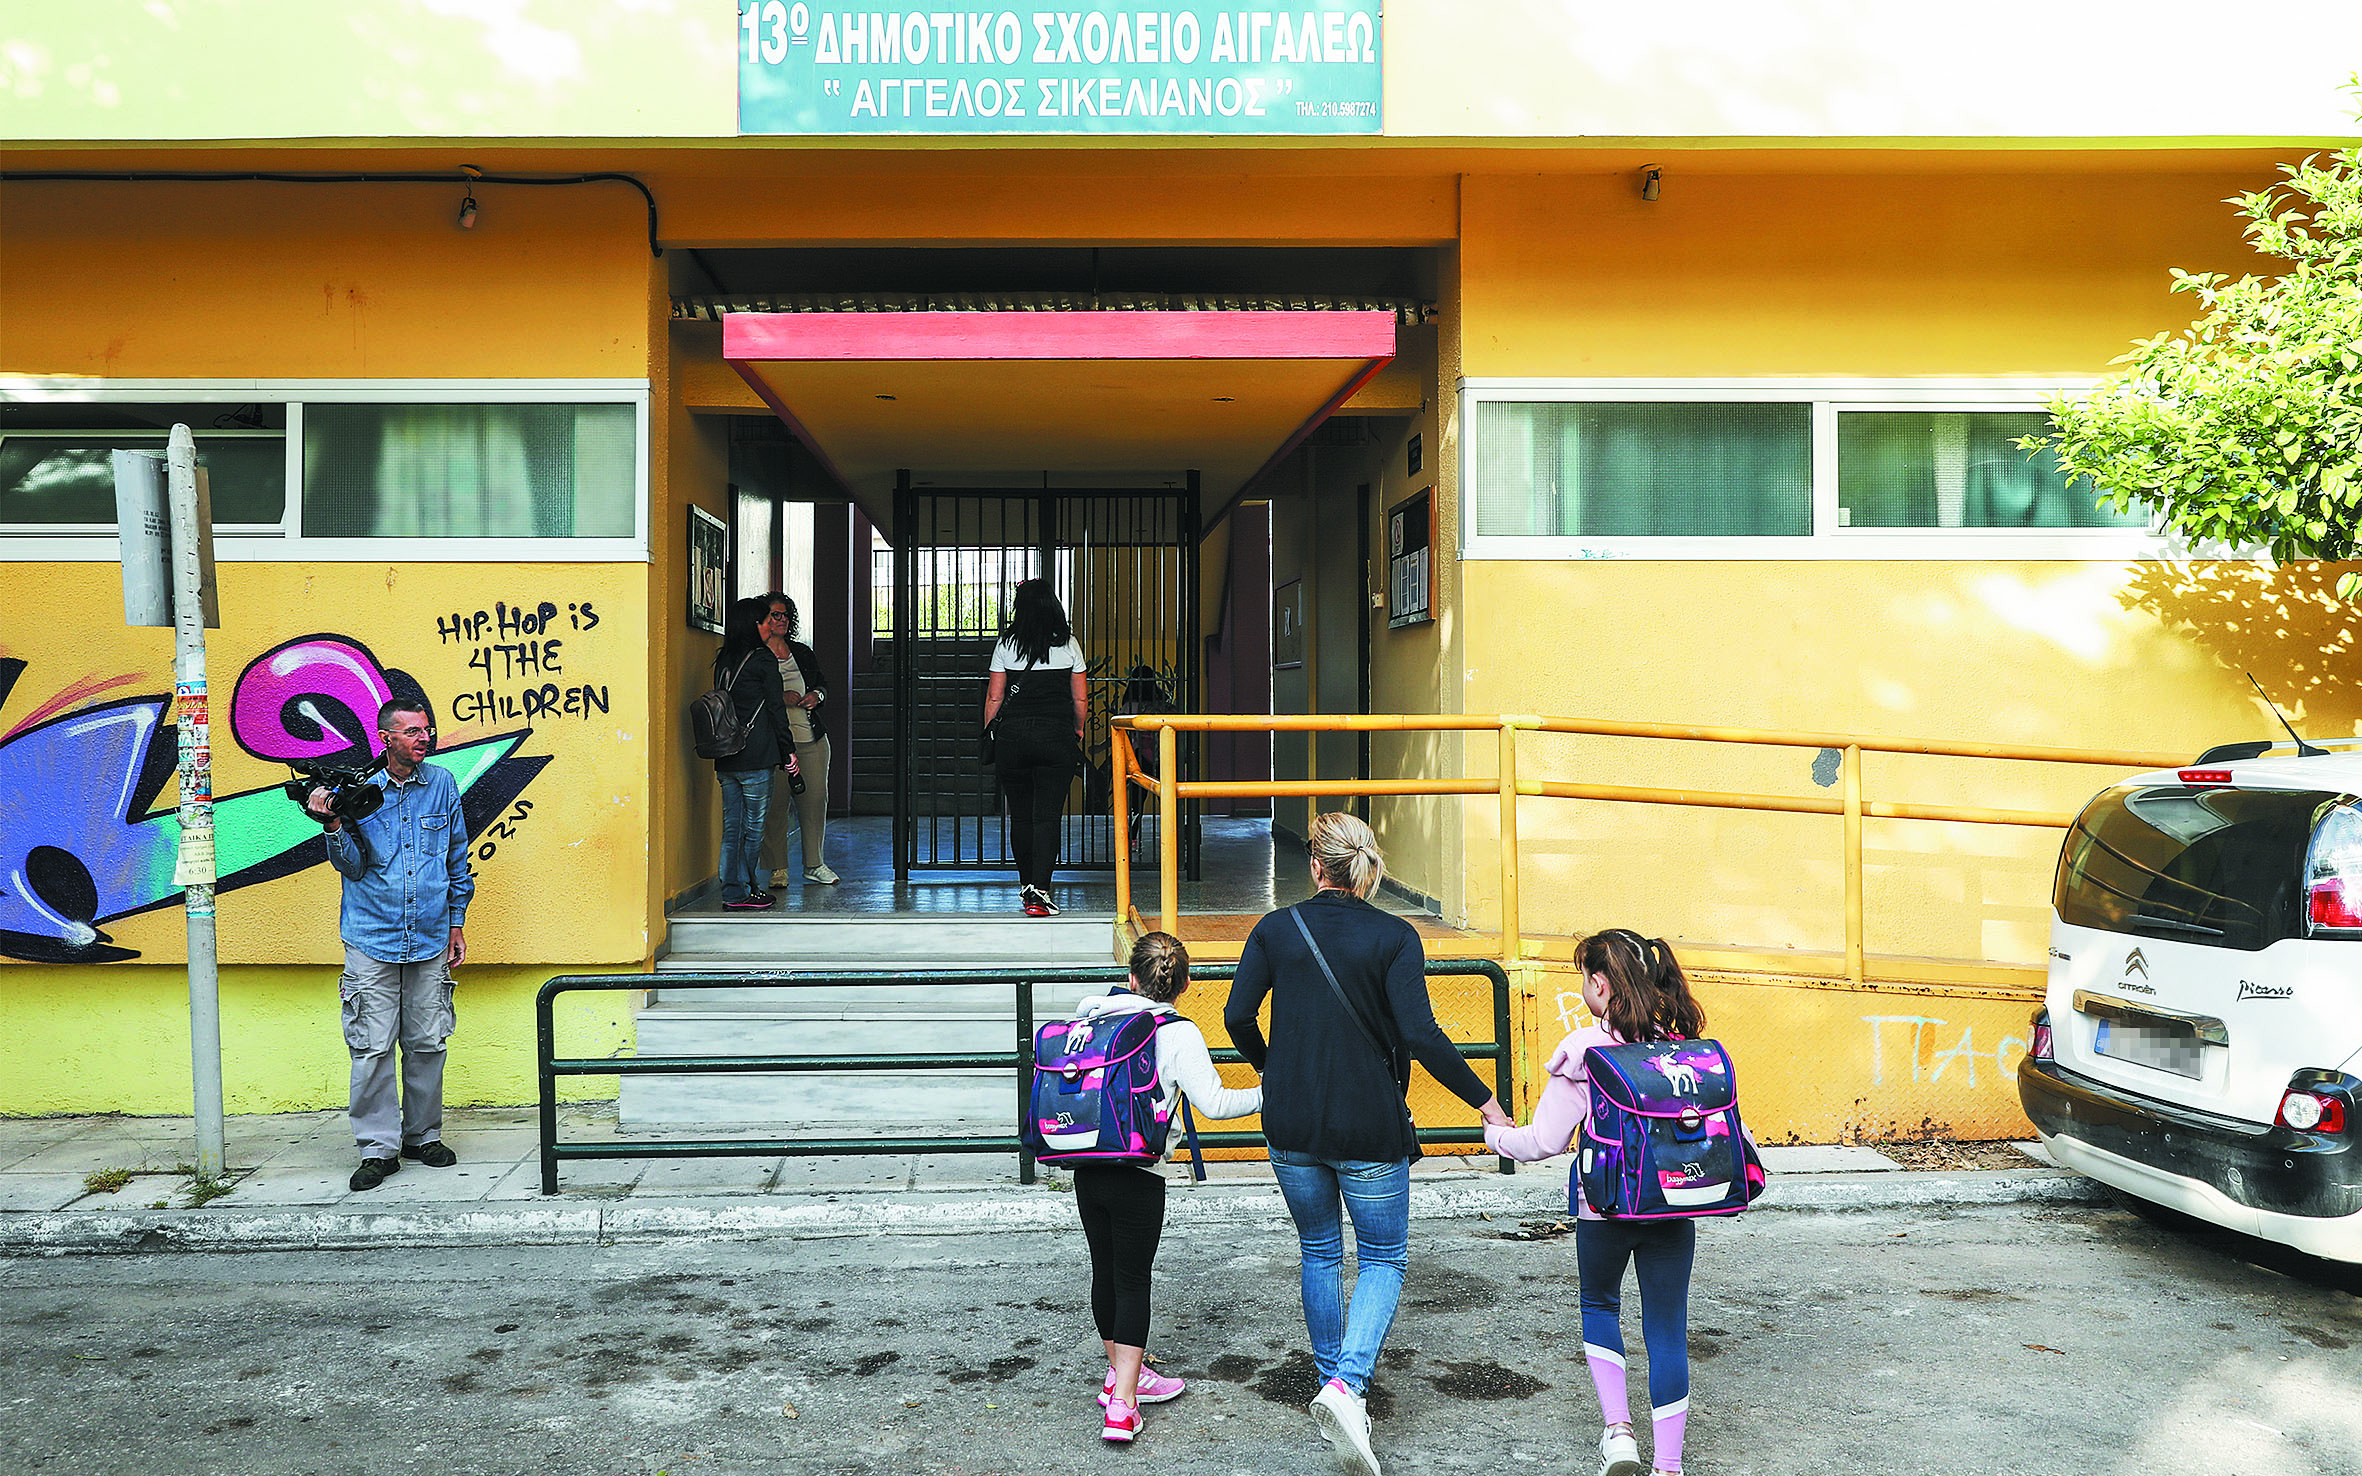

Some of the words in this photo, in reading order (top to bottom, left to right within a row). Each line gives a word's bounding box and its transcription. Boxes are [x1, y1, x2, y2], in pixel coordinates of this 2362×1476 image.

[814, 11, 1023, 65] ΔΗΜΟΤΙΚΟ
[1032, 11, 1201, 65] ΣΧΟΛΕΙΟ
[1210, 11, 1376, 64] ΑΙΓΑΛΕΩ
[452, 683, 609, 729] CHILDREN
